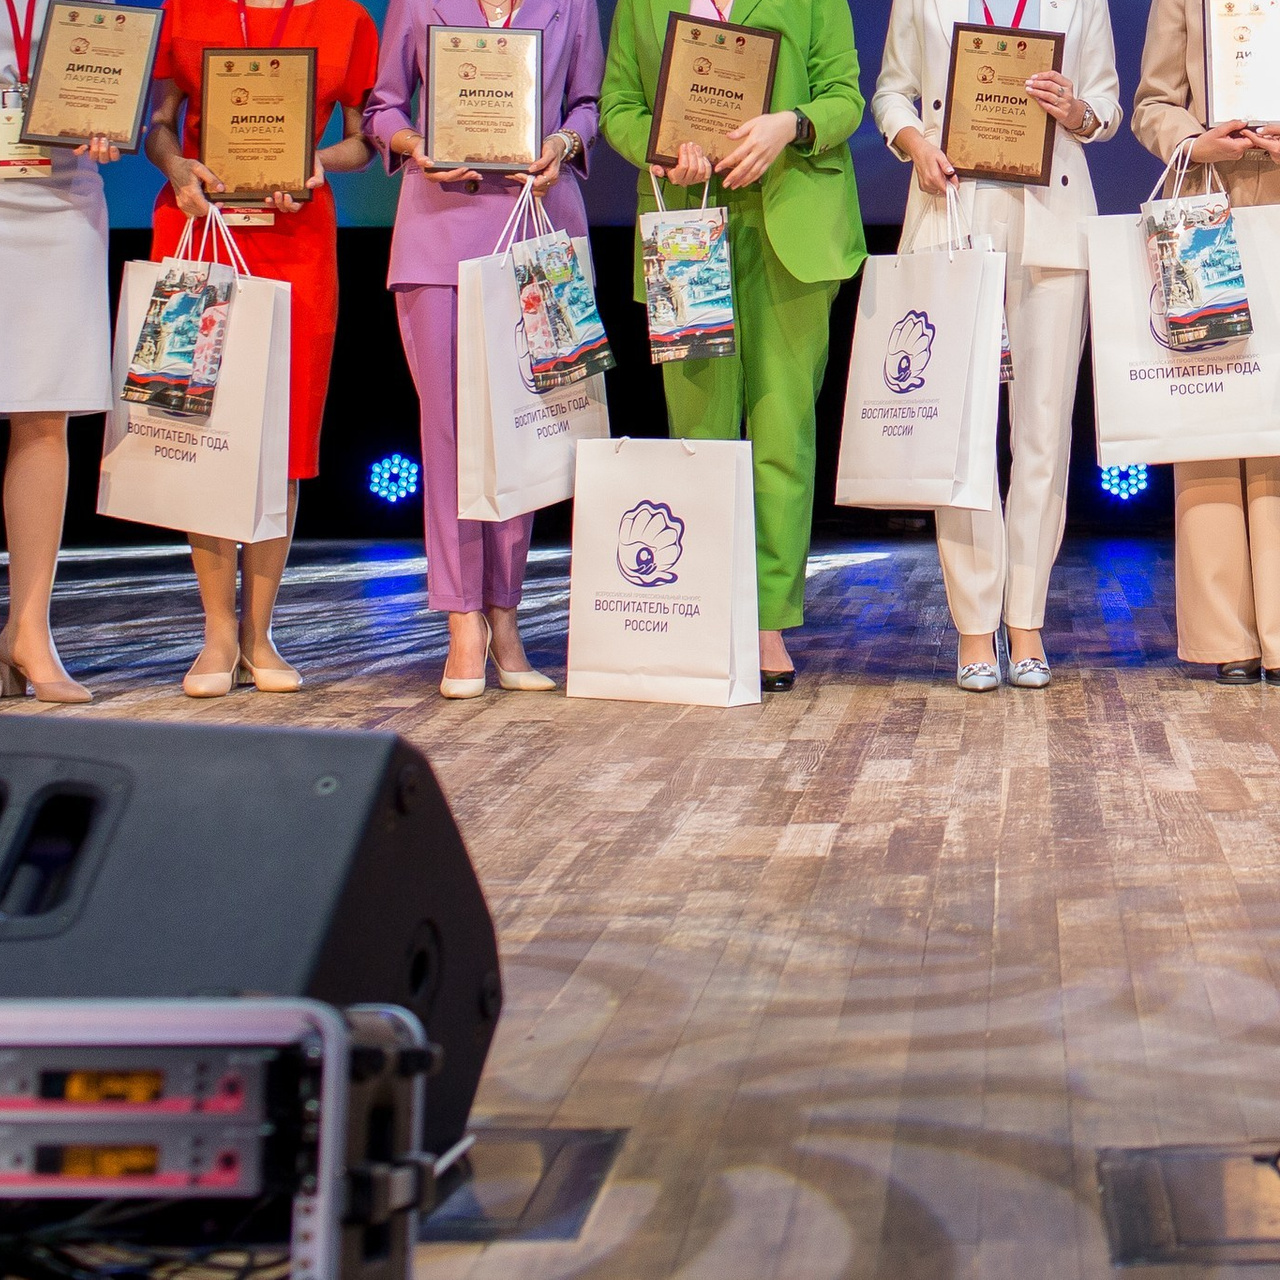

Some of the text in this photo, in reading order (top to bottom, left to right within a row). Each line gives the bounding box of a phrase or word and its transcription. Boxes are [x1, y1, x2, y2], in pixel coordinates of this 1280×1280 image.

[65, 63, 122, 75] ДИПЛОМ
[63, 74, 120, 85] ЛАУРЕАТА
[458, 89, 514, 98] ДИПЛОМ
[690, 84, 744, 100] ДИПЛОМ
[976, 92, 1028, 106] ДИПЛОМ
[459, 100, 514, 108] ЛАУРЕАТА
[688, 94, 742, 110] ЛАУРЕАТА
[974, 104, 1026, 116] ЛАУРЕАТА
[230, 115, 285, 124] ДИПЛОМ
[230, 126, 284, 134] ЛАУРЕАТА
[1130, 362, 1261, 380] ВОСПИТАТЕЛЬ ГОДА
[1170, 382, 1224, 396] РОССИИ
[514, 403, 567, 428] ВОСПИТАТЕЛЬ
[568, 396, 590, 411] ГОДА
[861, 406, 938, 420] ВОСПИТАТЕЛЬ ГОДА
[127, 422, 198, 446] ВОСПИТАТЕЛЬ
[200, 435, 230, 451] ГОДА
[536, 420, 570, 440] РОССИИ
[882, 425, 914, 436] РОССИИ
[154, 445, 197, 463] РОССИИ
[594, 599, 700, 618] ВОСПИТАТЕЛЬ ГОДА
[624, 619, 668, 632] РОССИИ
